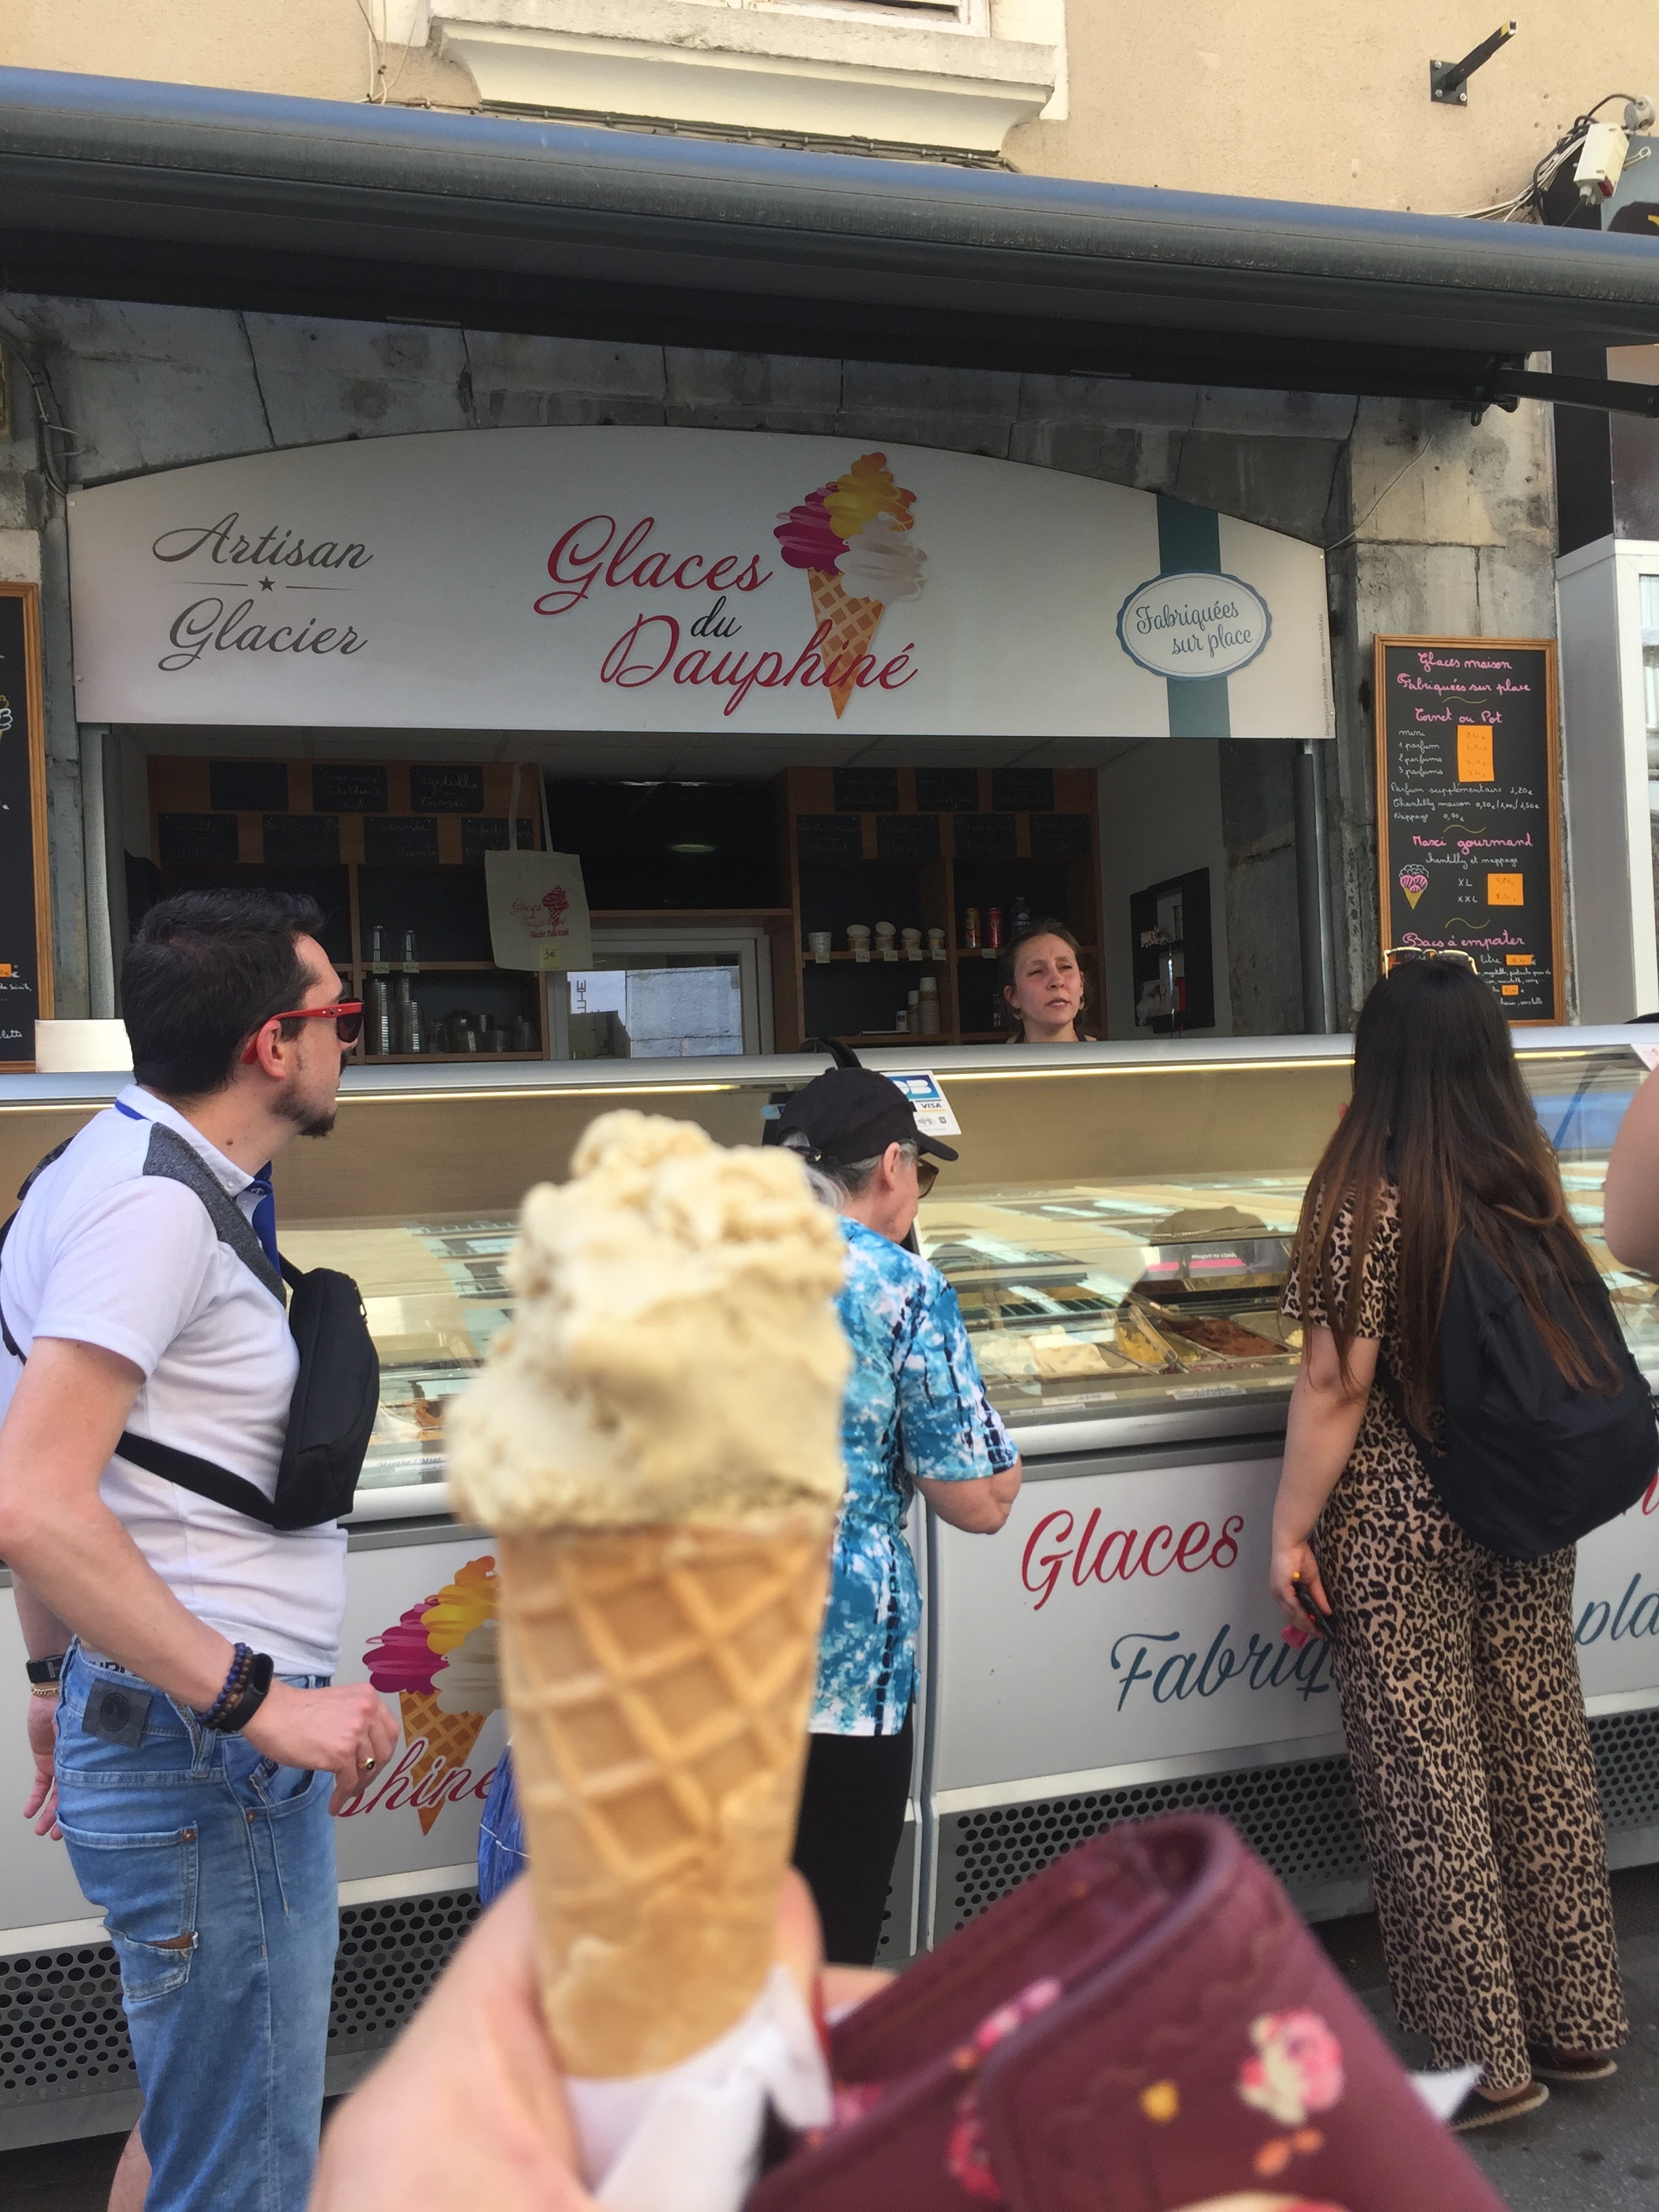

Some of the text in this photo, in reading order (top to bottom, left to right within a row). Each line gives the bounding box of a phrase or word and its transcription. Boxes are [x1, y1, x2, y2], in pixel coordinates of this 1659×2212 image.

[152, 512, 373, 569] Artisan
[533, 515, 773, 615] Glaces
[690, 596, 742, 638] du
[1135, 600, 1239, 634] Fabriquées
[158, 598, 368, 672] Glacier
[1172, 623, 1253, 658] sur place
[600, 613, 918, 716] Dauphiné
[1418, 651, 1513, 672] Glaces maison
[1397, 673, 1466, 697] Fabriquées
[1496, 678, 1531, 696] place
[1415, 707, 1452, 722] Cornet
[1481, 710, 1502, 723] Pot
[1405, 739, 1440, 754] parfum
[1398, 753, 1443, 766] 2 parfums
[1405, 766, 1443, 779] parfums
[1391, 782, 1425, 796] Parfum
[1429, 781, 1502, 796] supplémentaire
[1393, 797, 1436, 811] Chantilly
[1394, 812, 1429, 823] Nappage
[1412, 832, 1533, 855] Maxi gourmand
[1470, 855, 1479, 863] et
[1458, 878, 1473, 886] XL
[1458, 895, 1478, 903] XXL
[1402, 932, 1444, 947] Bacs
[1448, 935, 1458, 946] à
[544, 949, 557, 960] 3€
[1021, 1507, 1244, 1610] Glaces
[1111, 1624, 1334, 1712] Fabriq
